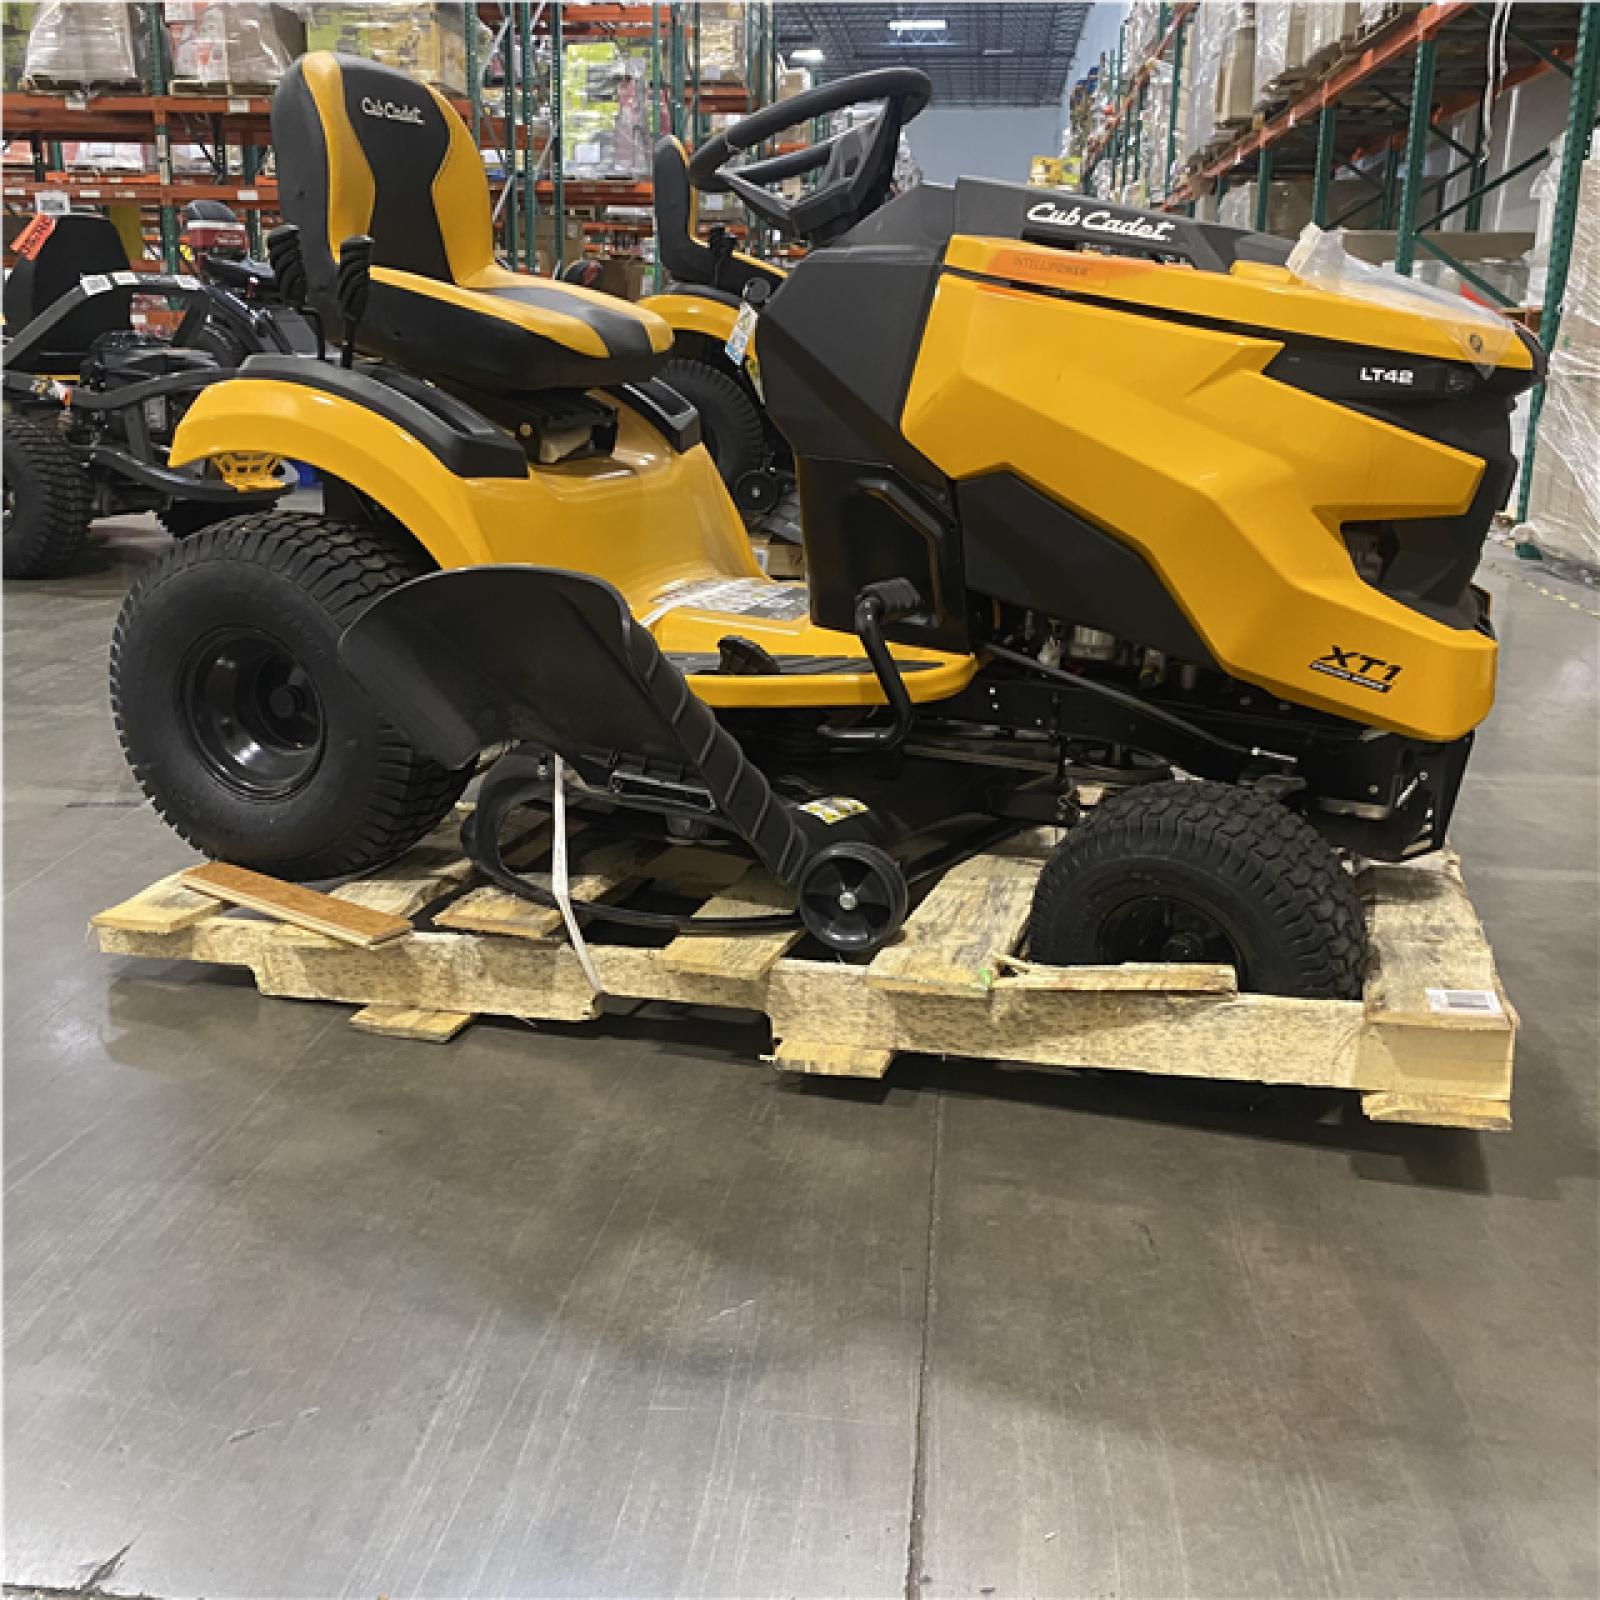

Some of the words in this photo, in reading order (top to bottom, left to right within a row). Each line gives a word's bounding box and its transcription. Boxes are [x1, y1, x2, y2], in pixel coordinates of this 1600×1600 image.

[361, 97, 383, 117] Cub
[384, 102, 424, 125] Cadet
[1027, 202, 1081, 226] Cub
[1082, 210, 1175, 241] Cadet
[1360, 367, 1413, 385] LT42
[1317, 645, 1402, 681] XT1
